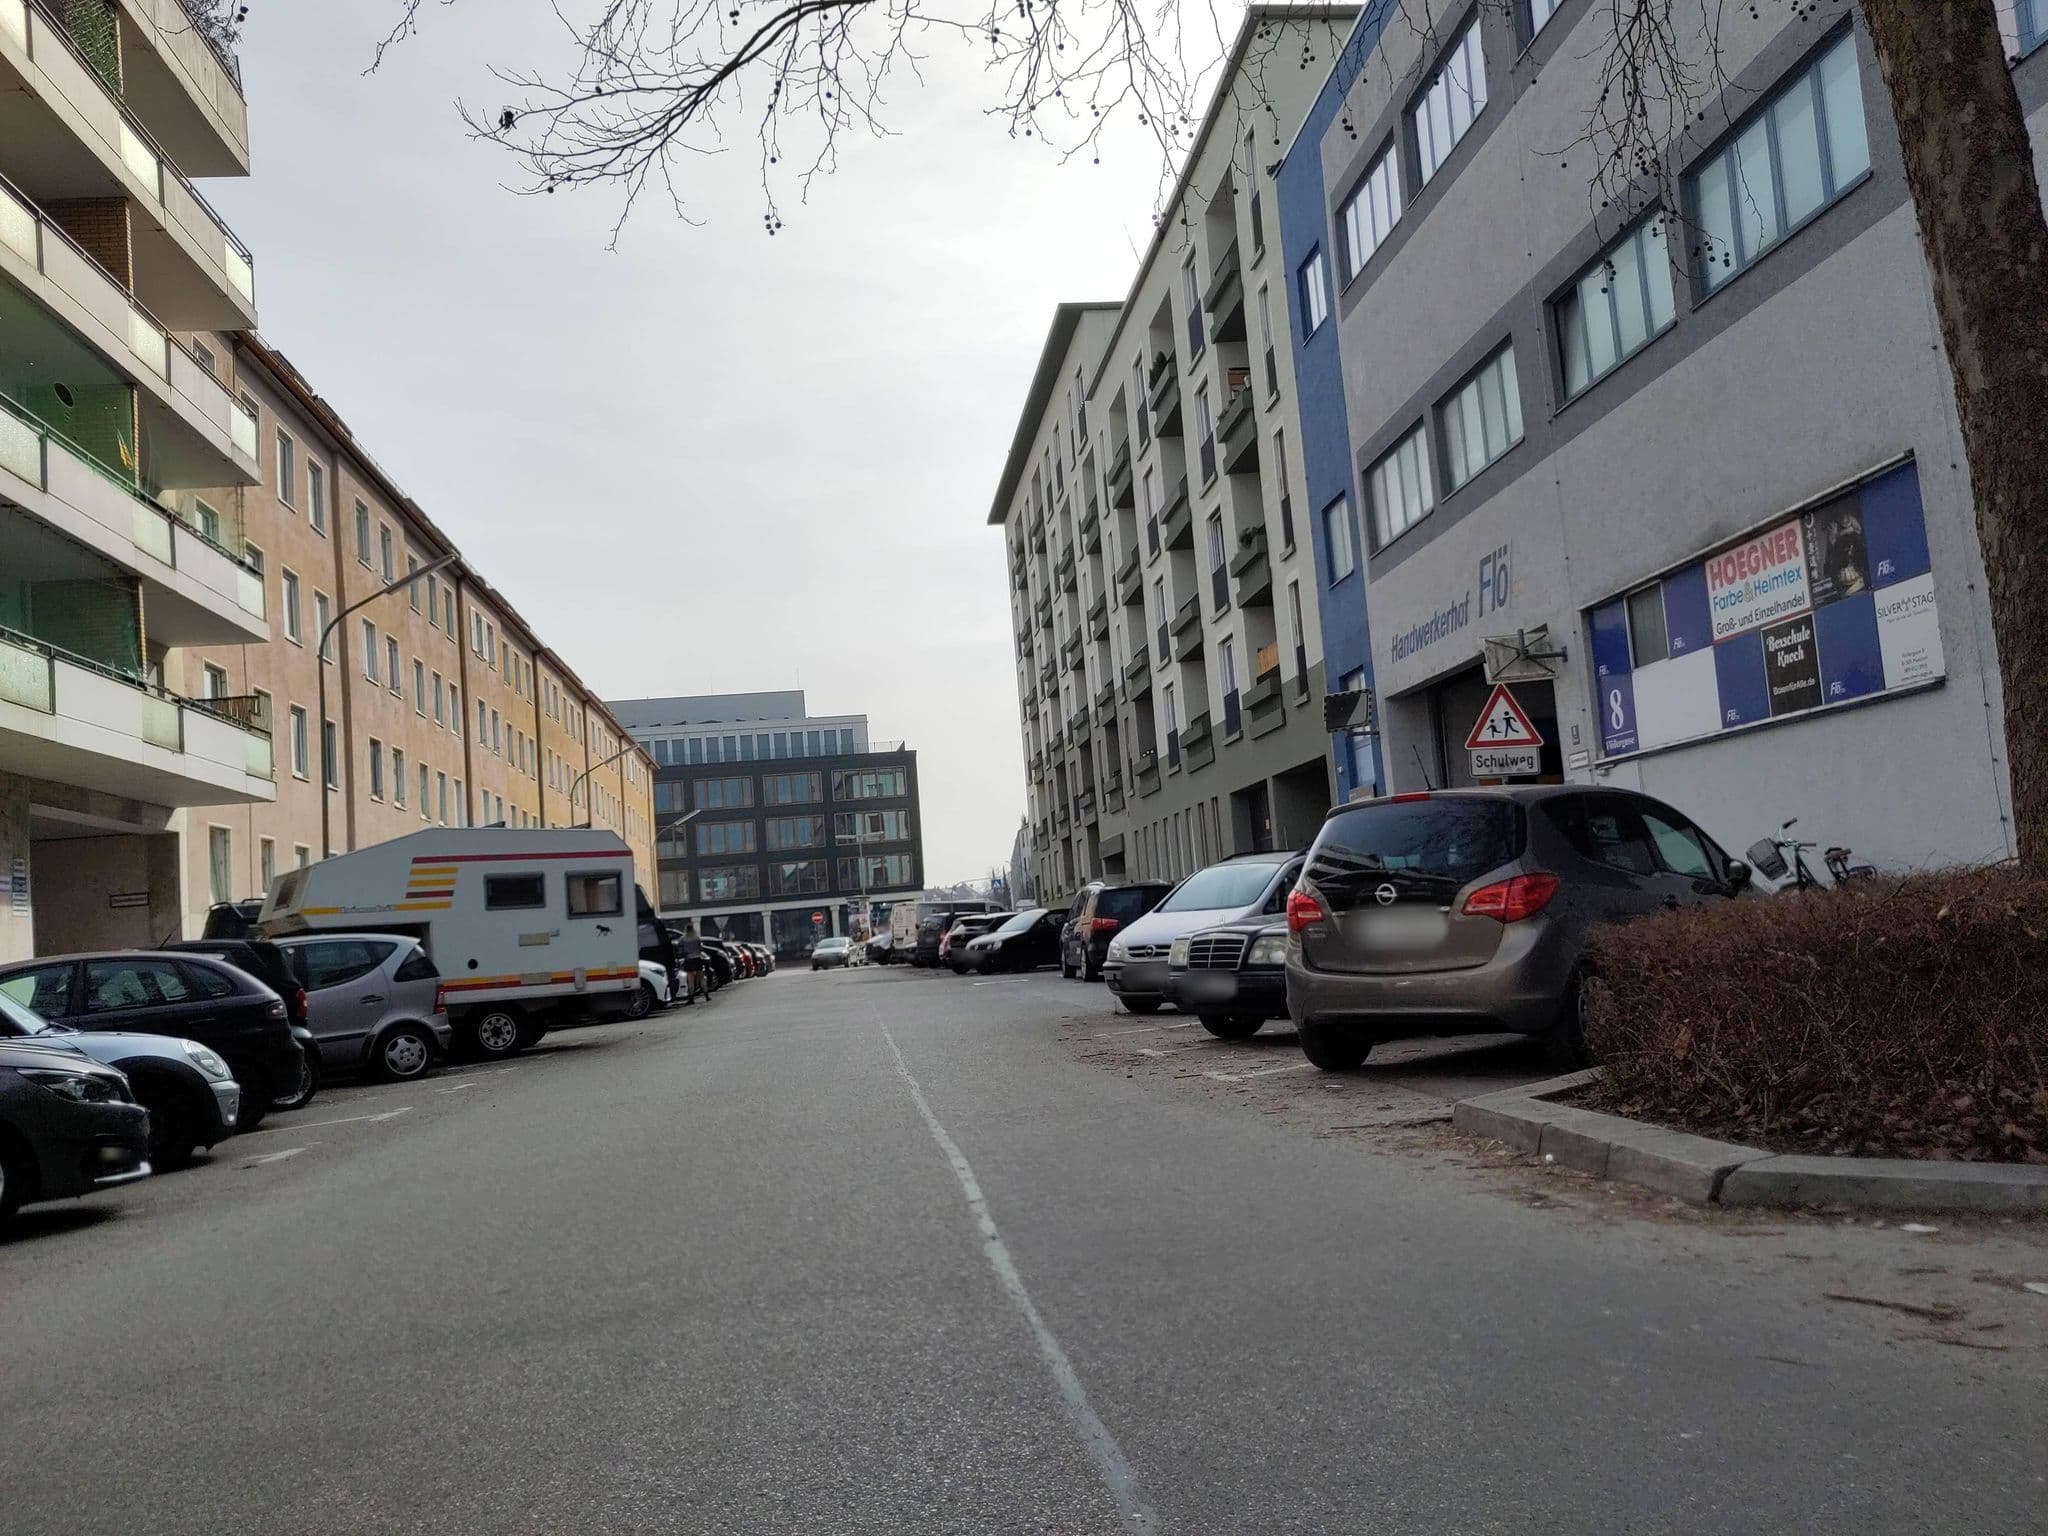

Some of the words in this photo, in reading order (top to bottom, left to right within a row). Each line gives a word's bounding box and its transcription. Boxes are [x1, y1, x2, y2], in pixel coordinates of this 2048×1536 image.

[1709, 528, 1799, 592] HOEGNER
[1391, 592, 1470, 664] Handwerkerhof
[1478, 543, 1509, 618] Flö
[1712, 589, 1743, 612] Farbe
[1743, 581, 1755, 603] &
[1753, 566, 1802, 597] Heimtex
[1877, 602, 1903, 619] SILVER
[1716, 617, 1737, 634] Groß-
[1738, 611, 1754, 627] und
[1754, 591, 1805, 621] Einzelhandel
[1609, 689, 1624, 730] 8
[1475, 753, 1534, 770] Schulweg
